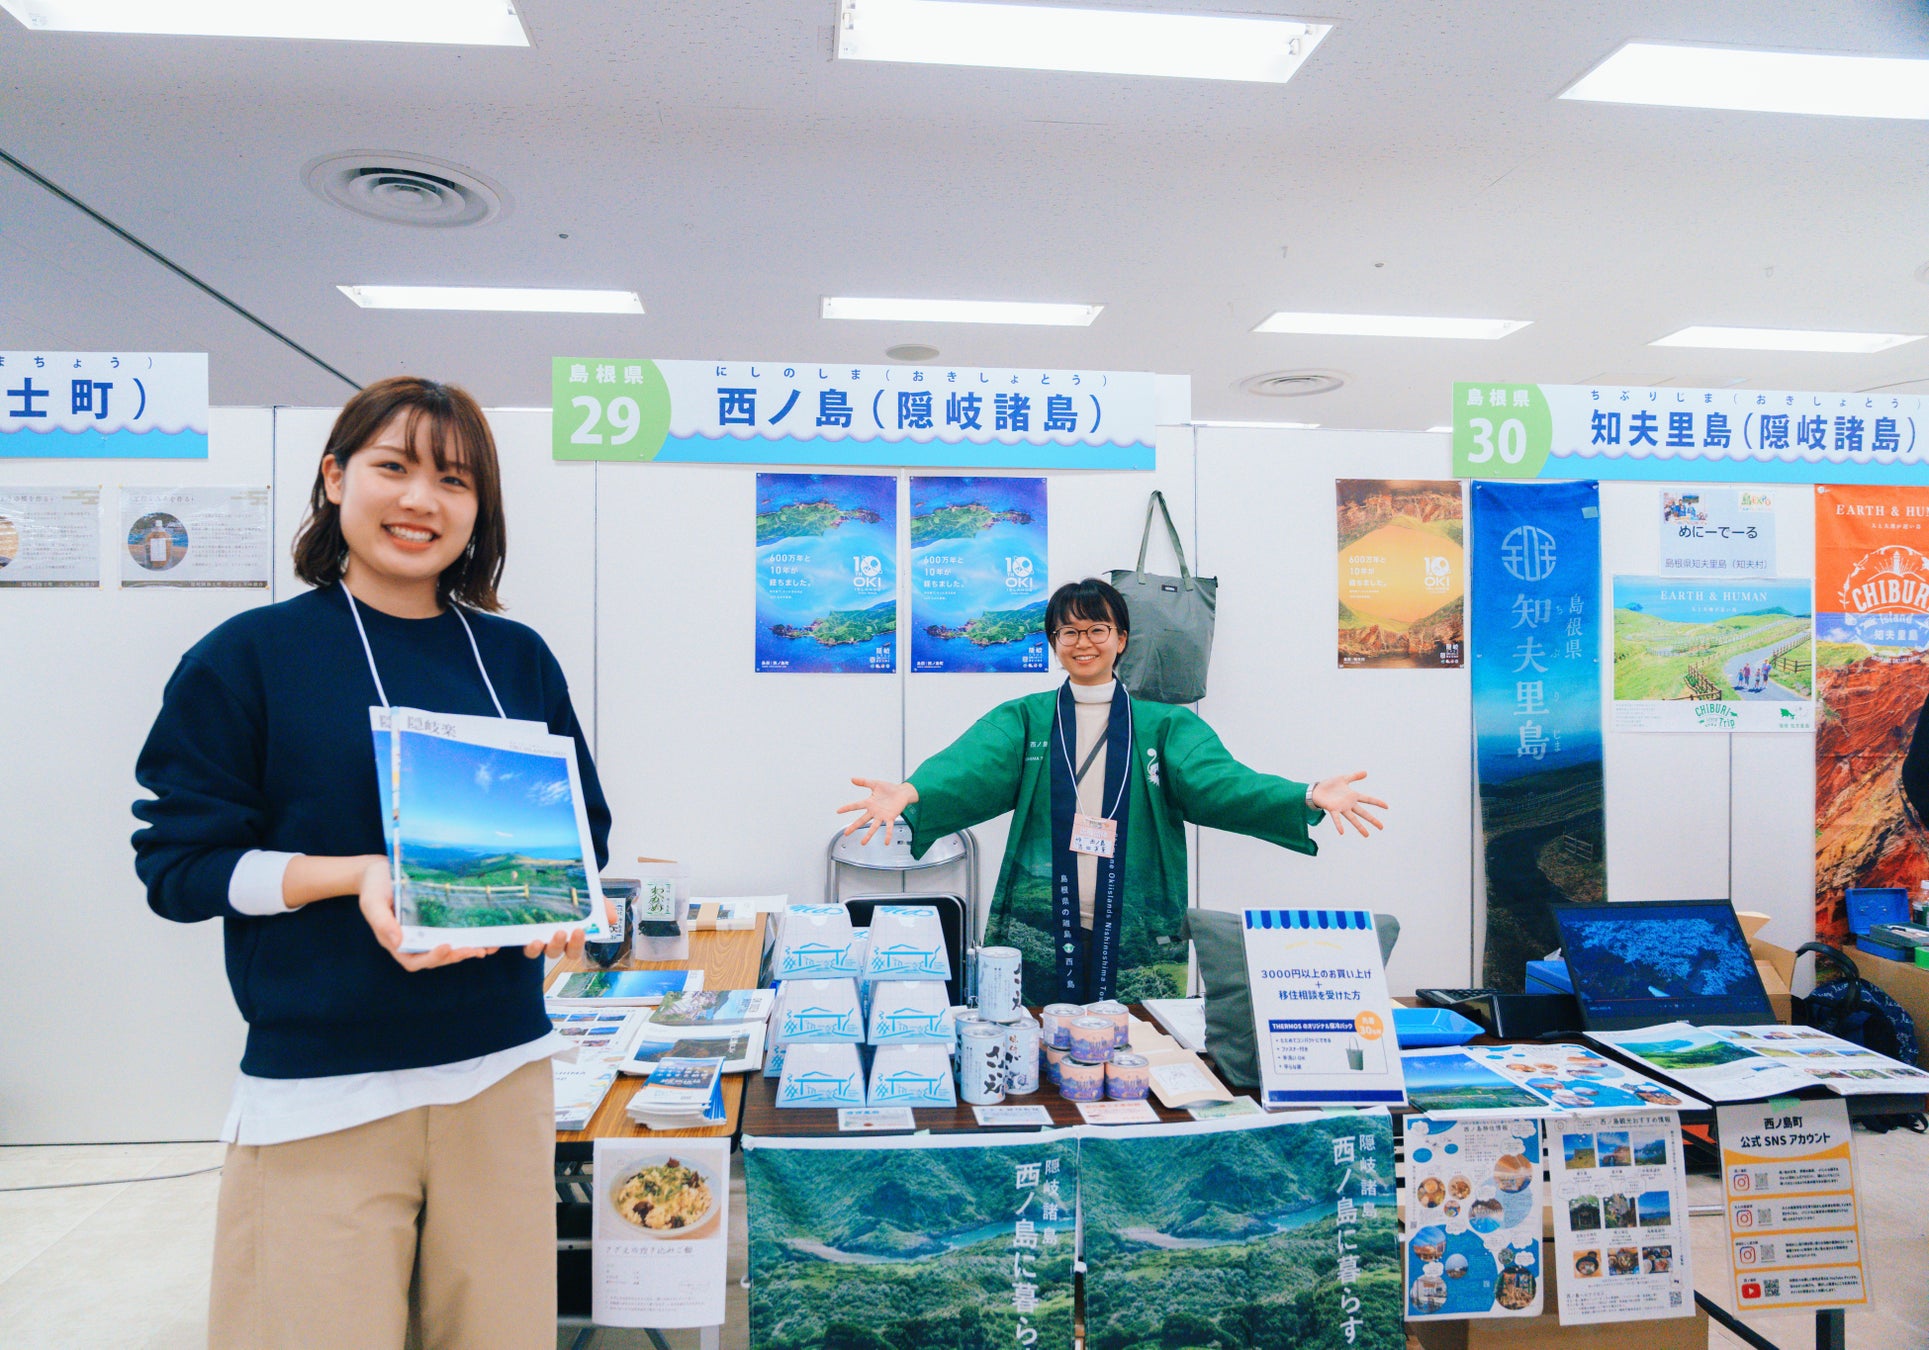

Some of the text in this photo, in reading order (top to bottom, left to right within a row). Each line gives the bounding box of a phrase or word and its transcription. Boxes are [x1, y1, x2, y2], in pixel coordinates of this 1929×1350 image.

[569, 364, 643, 385] 島根県
[1467, 389, 1530, 407] 島根県
[570, 395, 640, 446] 29
[717, 387, 1101, 433] 西ノ島（隠岐諸島）
[1467, 417, 1527, 463] 30
[1591, 408, 1917, 453] 知夫里島（隠岐諸島）
[1836, 504, 1929, 517] EARTH & HU
[1678, 526, 1758, 539] めにーてーる
[853, 577, 881, 588] OKI
[1005, 577, 1033, 588] OKI
[1424, 576, 1450, 587] OKI
[1660, 591, 1768, 601] EARTH & HUMAN
[1851, 579, 1929, 612] CHIBUR
[1564, 593, 1583, 660] 島根県
[1511, 593, 1551, 760] 知夫里島
[1694, 703, 1731, 716] CHIBURI
[1060, 873, 1075, 990] 島根県の離島 西ノ島
[1261, 968, 1373, 980] 3000円以上のお買い上げ
[1278, 989, 1361, 1001] 移住相談を受けた方
[1763, 1116, 1803, 1131] 西ノ島町
[1740, 1132, 1831, 1149] 公式 SNS アカウント
[1359, 1133, 1378, 1218] 隠岐諸島
[1043, 1159, 1061, 1245] 隠岐諸島
[1332, 1135, 1364, 1345] 西ノ島に暮らす
[1013, 1161, 1042, 1350] 西ノ島に暮ら
